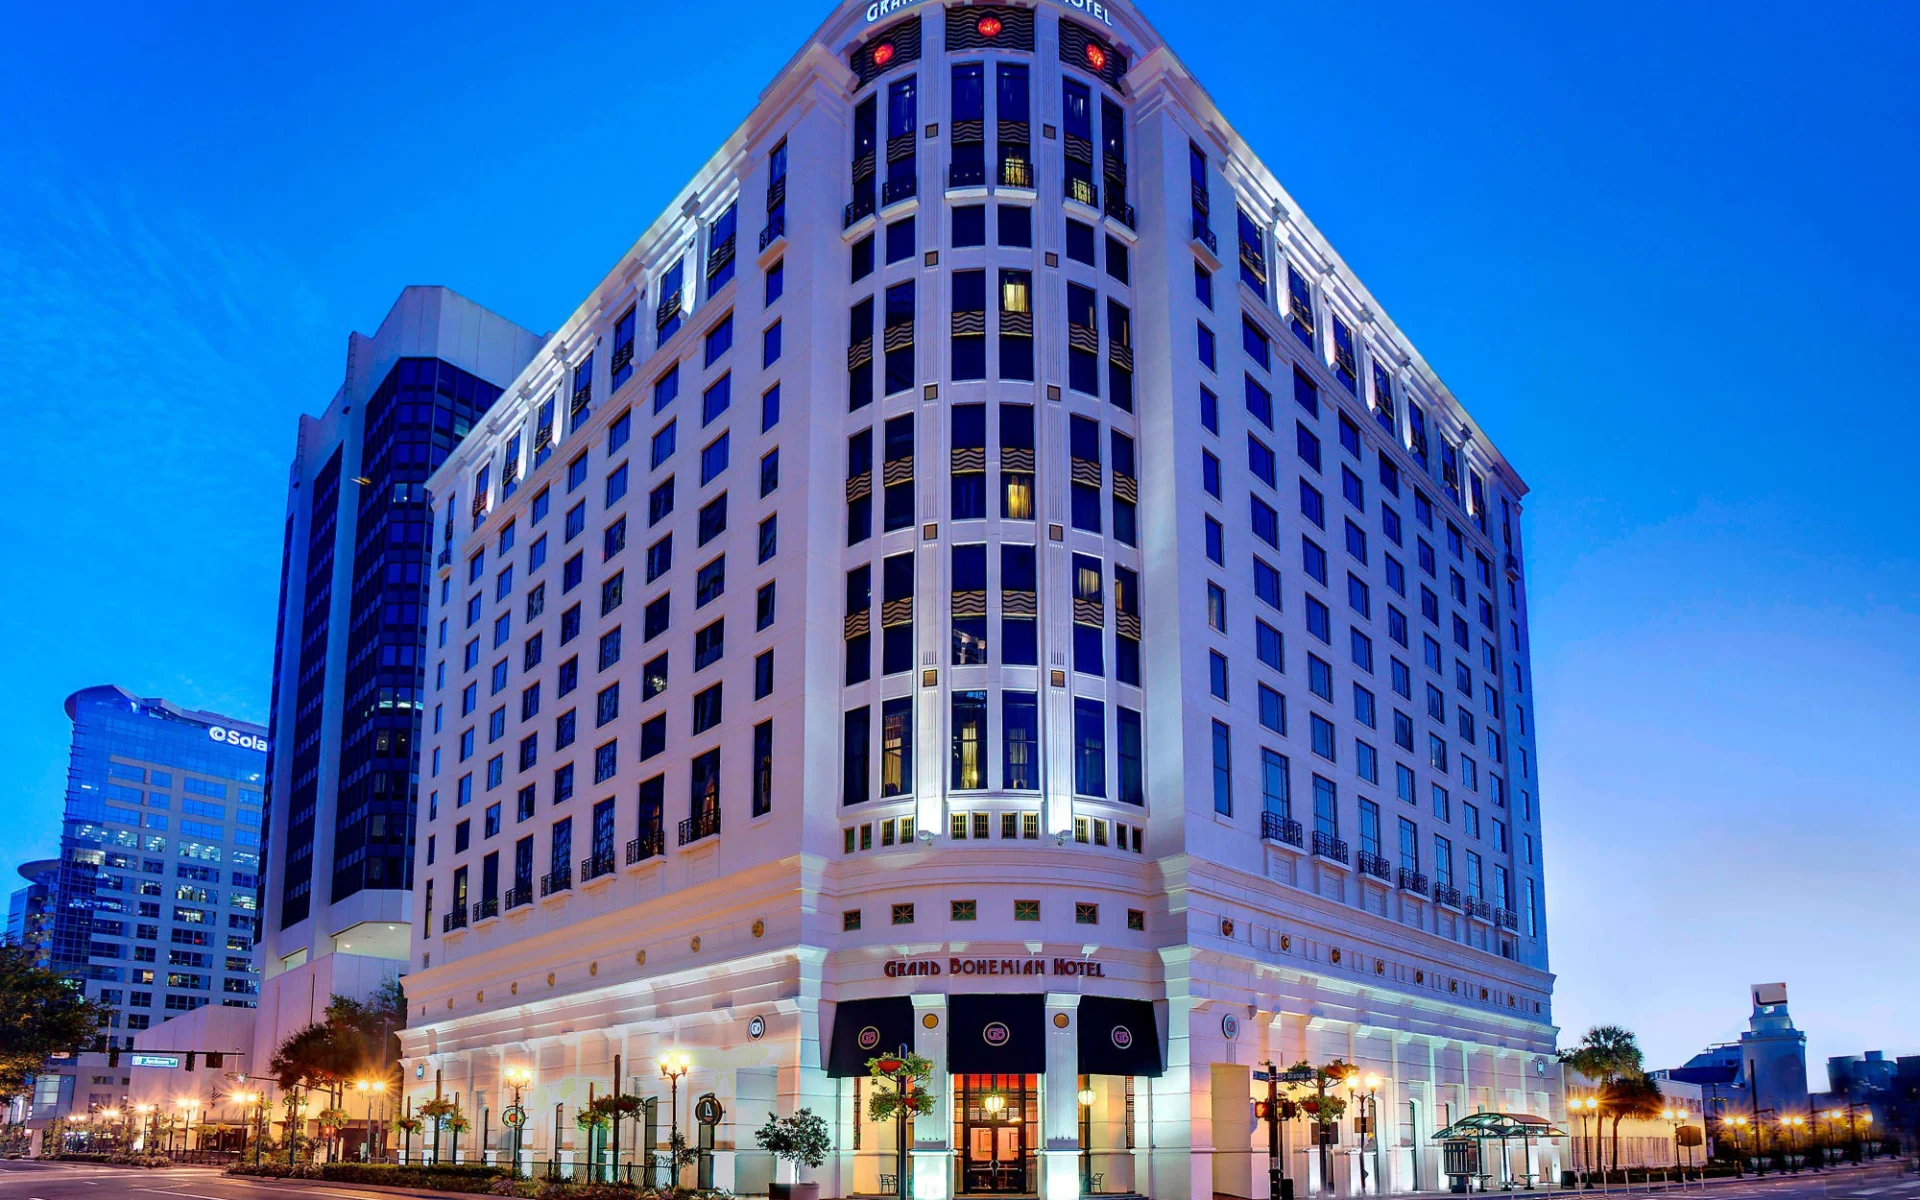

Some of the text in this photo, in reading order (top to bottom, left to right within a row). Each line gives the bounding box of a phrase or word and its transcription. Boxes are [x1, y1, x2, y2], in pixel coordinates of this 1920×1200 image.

[866, 0, 913, 21] GRA
[883, 957, 1105, 977] GRAND BOHEMIAN HOTEL
[988, 1027, 1005, 1040] GB
